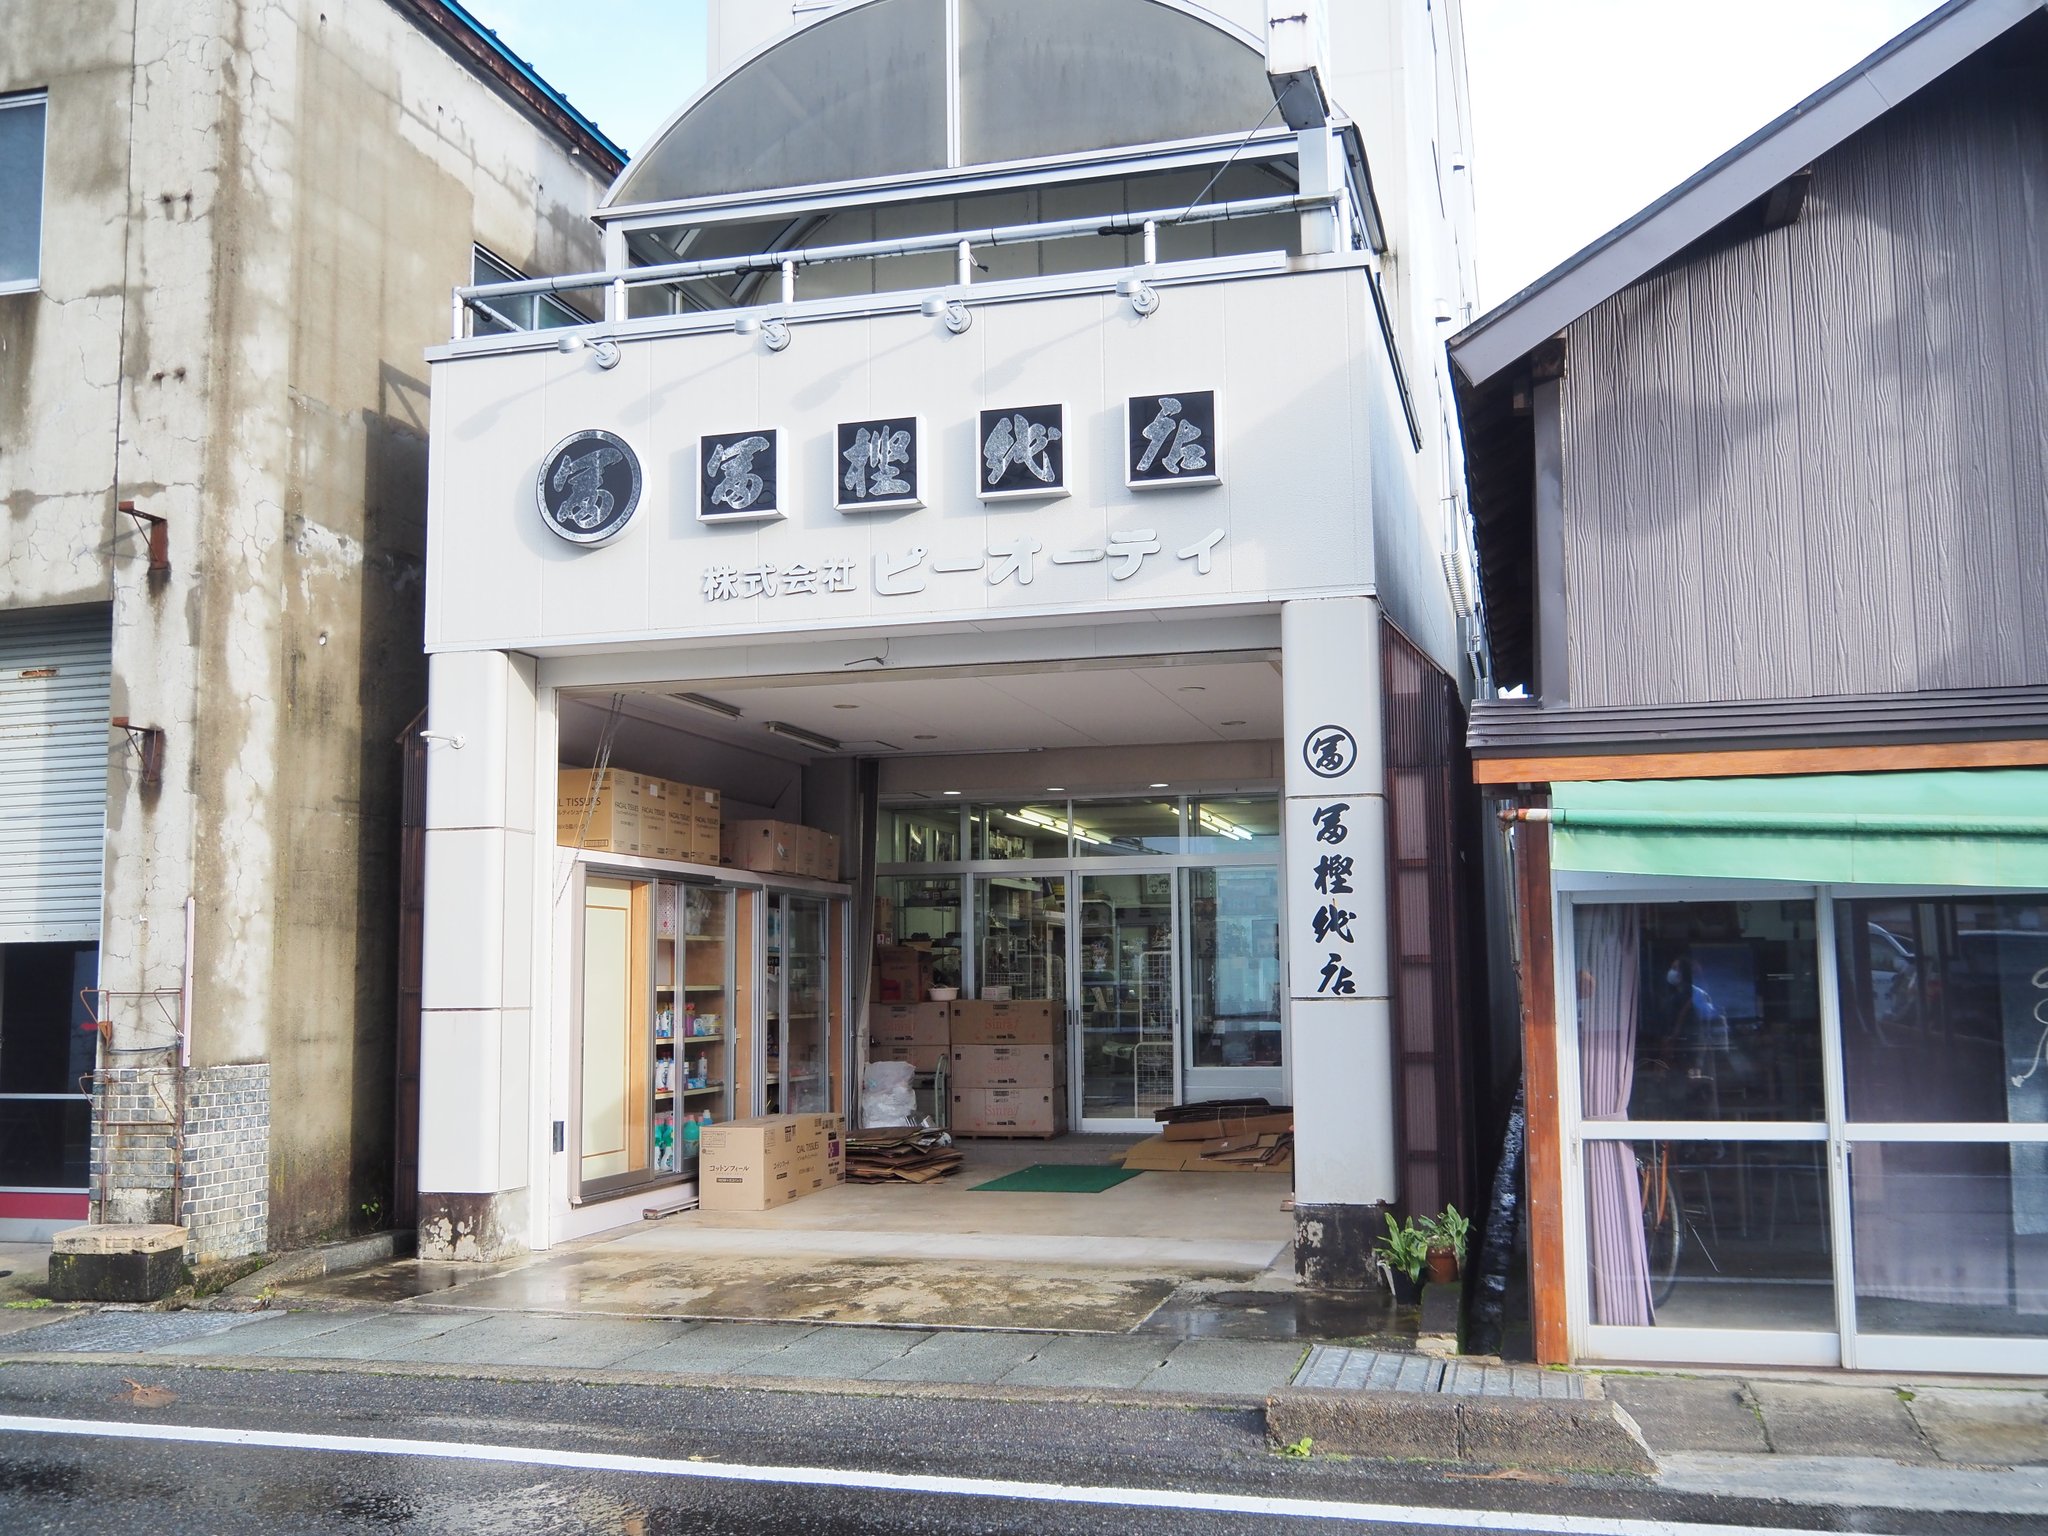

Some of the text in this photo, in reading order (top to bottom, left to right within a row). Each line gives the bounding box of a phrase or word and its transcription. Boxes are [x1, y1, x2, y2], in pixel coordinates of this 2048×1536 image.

[703, 557, 857, 601] 株式会社
[709, 1164, 750, 1172] コットンフィール
